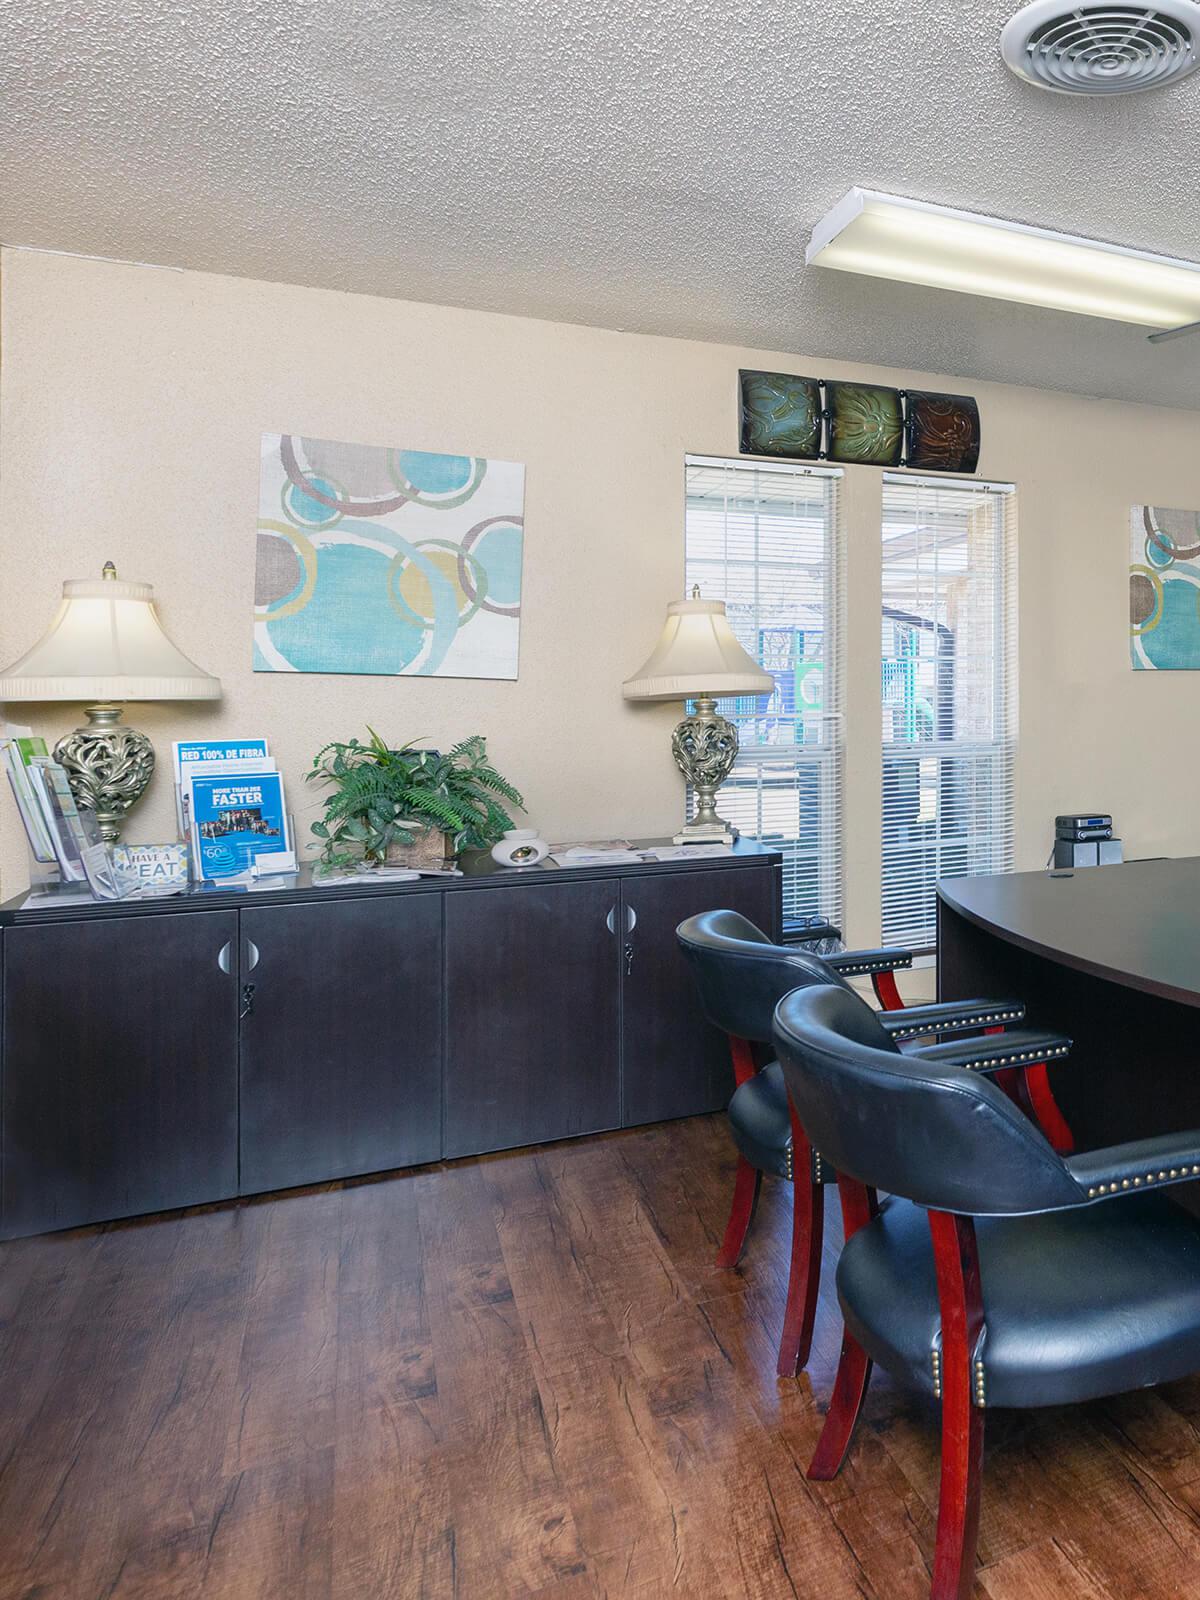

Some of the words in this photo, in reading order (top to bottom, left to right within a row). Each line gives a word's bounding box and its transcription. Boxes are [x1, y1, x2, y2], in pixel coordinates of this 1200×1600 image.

[182, 751, 200, 761] RED
[202, 749, 224, 760] 100%
[226, 749, 238, 759] DE
[239, 747, 265, 758] FIBRA
[212, 792, 263, 806] FASTER
[132, 854, 160, 863] HAVE
[163, 853, 171, 861] A
